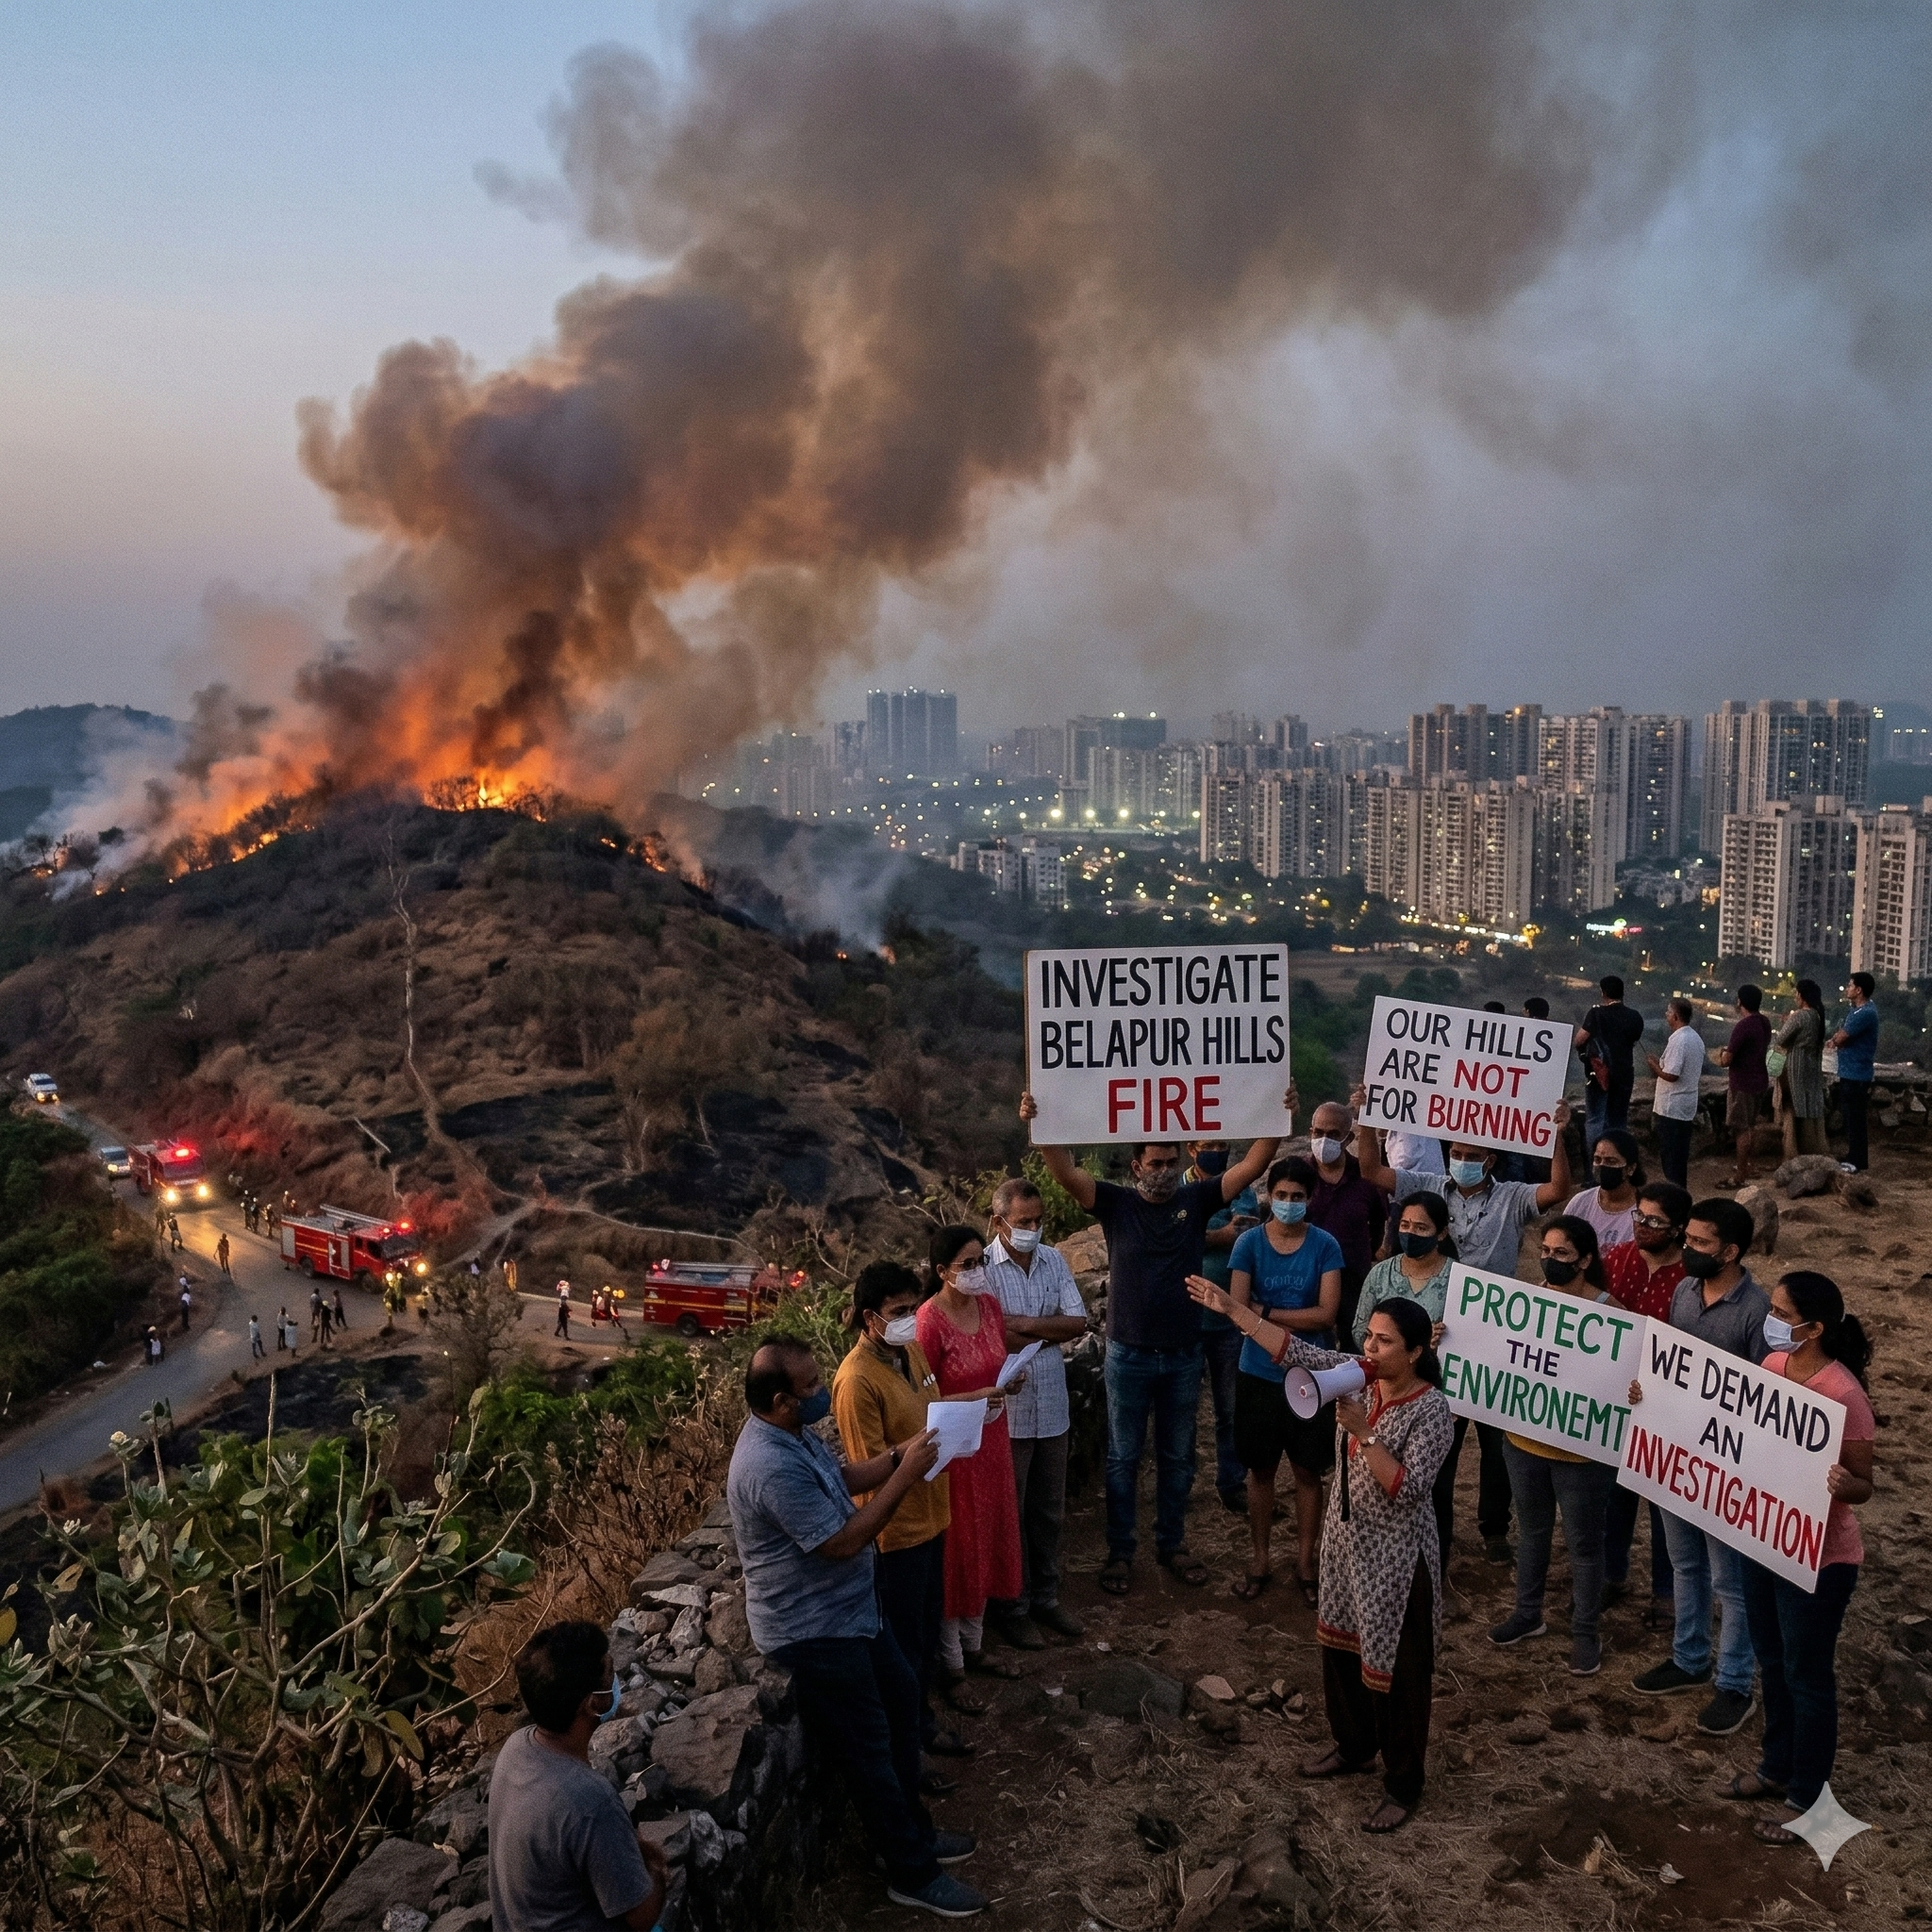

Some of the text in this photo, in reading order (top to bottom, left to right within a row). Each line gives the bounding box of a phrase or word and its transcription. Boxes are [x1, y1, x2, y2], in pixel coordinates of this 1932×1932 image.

[1041, 954, 1280, 1008] INVESTIGATE
[1041, 1015, 1285, 1070] BELAPUR HILLS
[1387, 1008, 1554, 1063] OUR HILLS
[1379, 1048, 1530, 1099] ARE NOT
[1108, 1076, 1222, 1134] FIRE
[1366, 1084, 1552, 1147] FOR BURNING
[1460, 1276, 1634, 1361] PROTECT
[1507, 1340, 1560, 1377] THE
[1442, 1353, 1632, 1453] ENVIRONEMT
[1652, 1334, 1830, 1453] WE DEMAND
[1699, 1417, 1744, 1465] AN
[1627, 1425, 1824, 1573] INVESTIGATION
